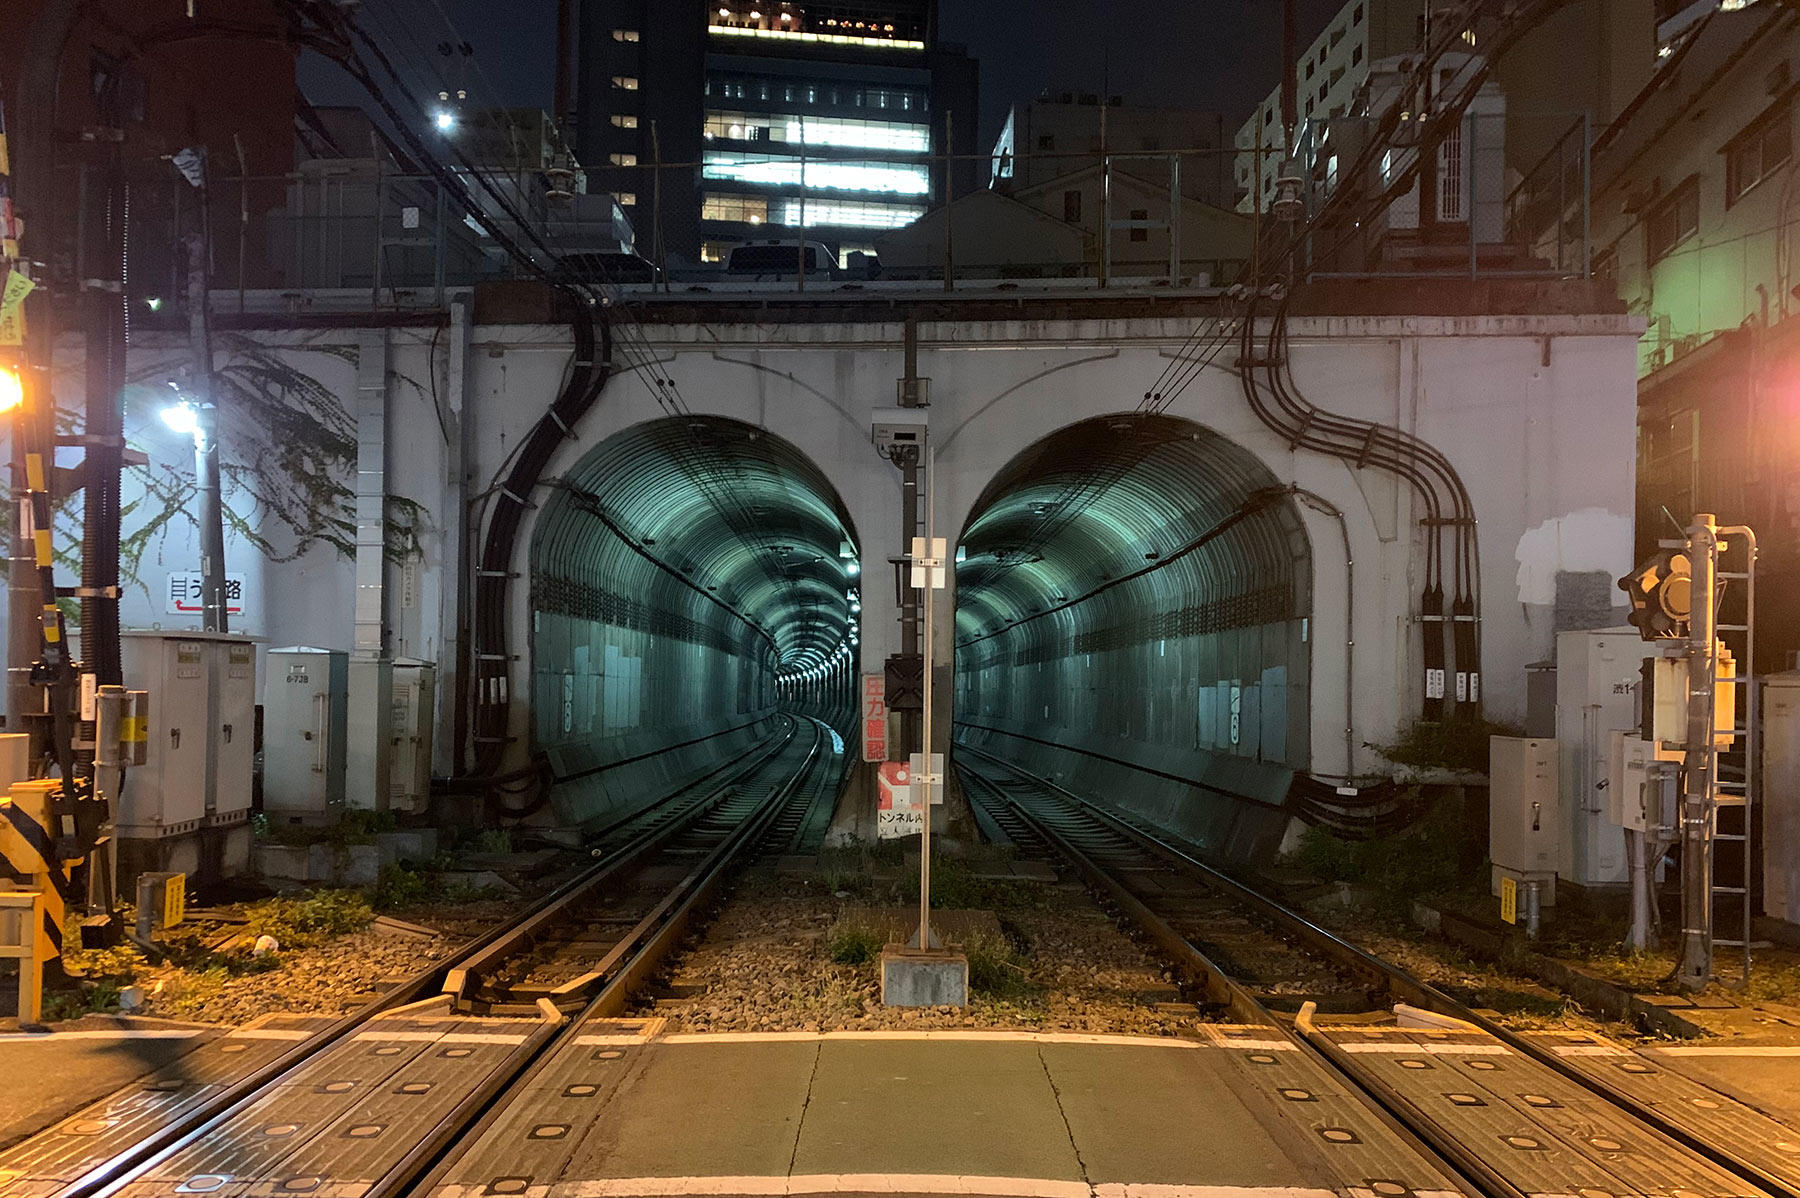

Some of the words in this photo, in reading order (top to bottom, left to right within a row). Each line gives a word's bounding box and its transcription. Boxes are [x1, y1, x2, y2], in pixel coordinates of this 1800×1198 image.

[190, 579, 241, 599] う路
[866, 677, 885, 759] 圧力確認
